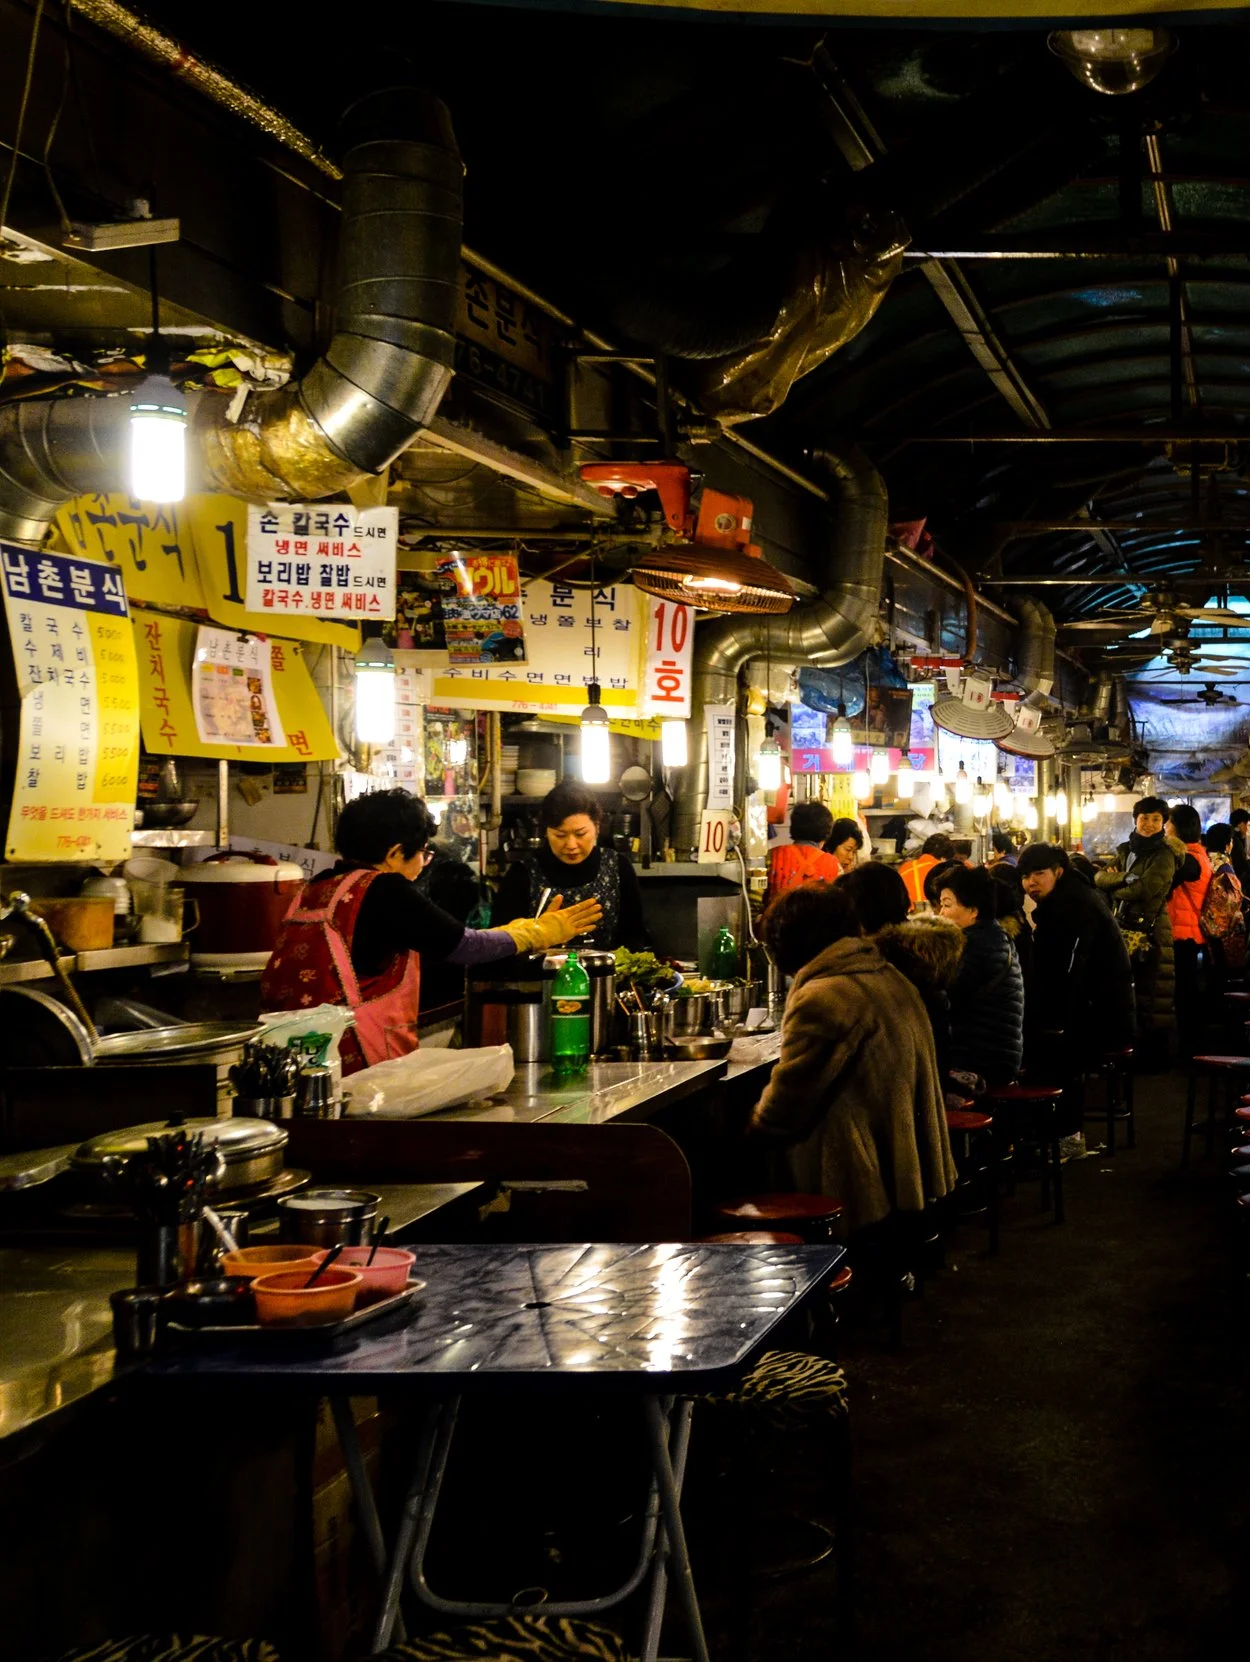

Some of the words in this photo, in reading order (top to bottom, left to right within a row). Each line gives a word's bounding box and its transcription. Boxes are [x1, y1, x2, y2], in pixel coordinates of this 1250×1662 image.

[260, 510, 279, 534] 손
[292, 512, 350, 537] 칼국수
[353, 526, 387, 539] 드시면
[275, 540, 308, 556] 냉면
[316, 542, 362, 558] 써비스
[3, 552, 127, 612] 남촌분식
[257, 560, 311, 586] 보리밥
[319, 564, 350, 588] 찰밥
[353, 576, 387, 588] 드시면
[341, 593, 381, 612] 써비스
[20, 613, 83, 640] 칼국수
[144, 621, 177, 748] 잔치국수
[703, 821, 724, 853] 10
